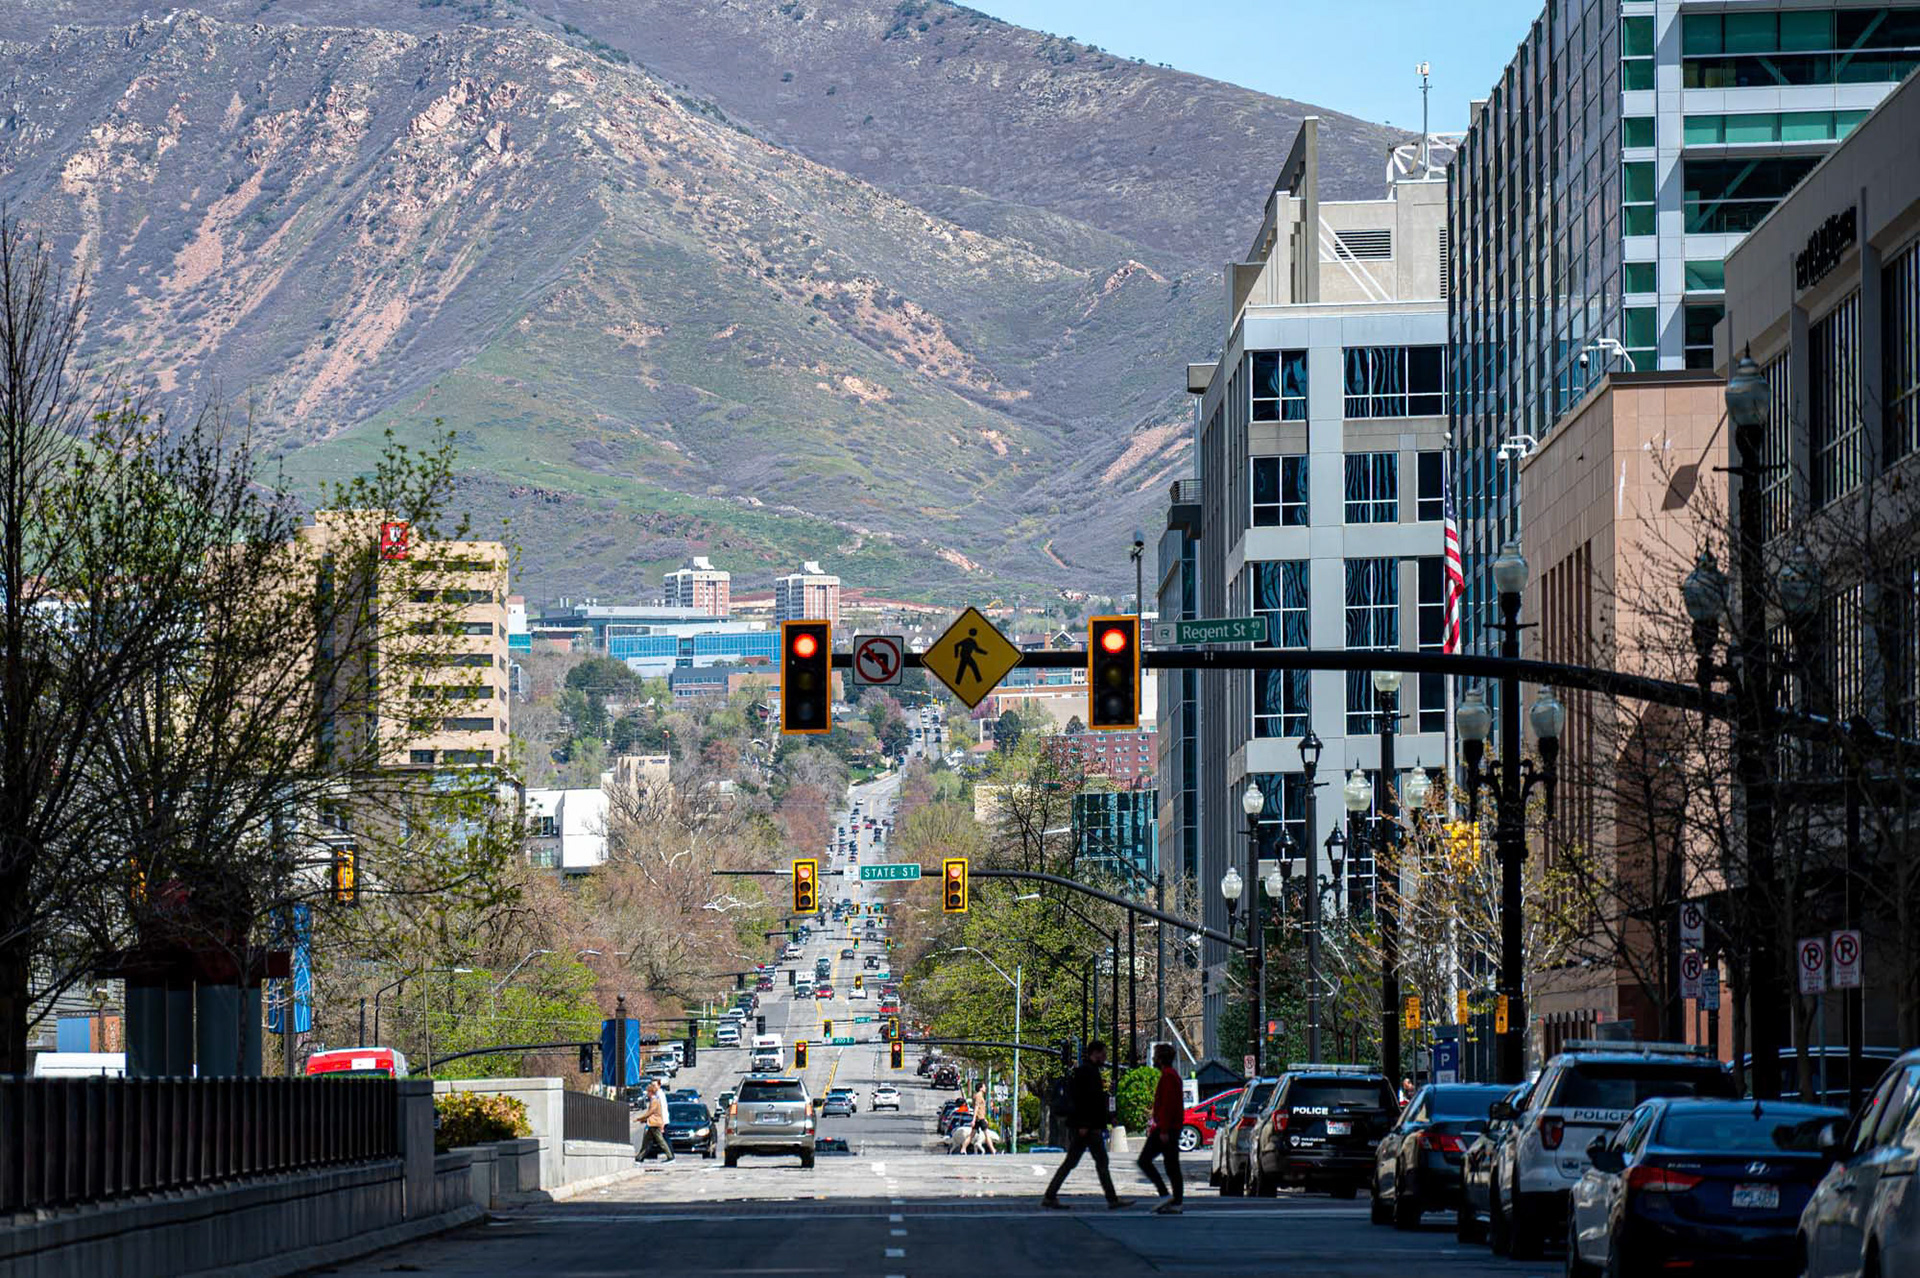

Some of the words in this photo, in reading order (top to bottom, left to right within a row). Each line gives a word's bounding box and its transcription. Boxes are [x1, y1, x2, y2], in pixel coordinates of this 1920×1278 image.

[1182, 624, 1229, 642] Regent
[1233, 622, 1246, 637] St
[864, 867, 896, 878] STATE
[1441, 1053, 1450, 1067] P
[1292, 1106, 1329, 1115] POLICE
[1573, 1110, 1629, 1121] POLICE
